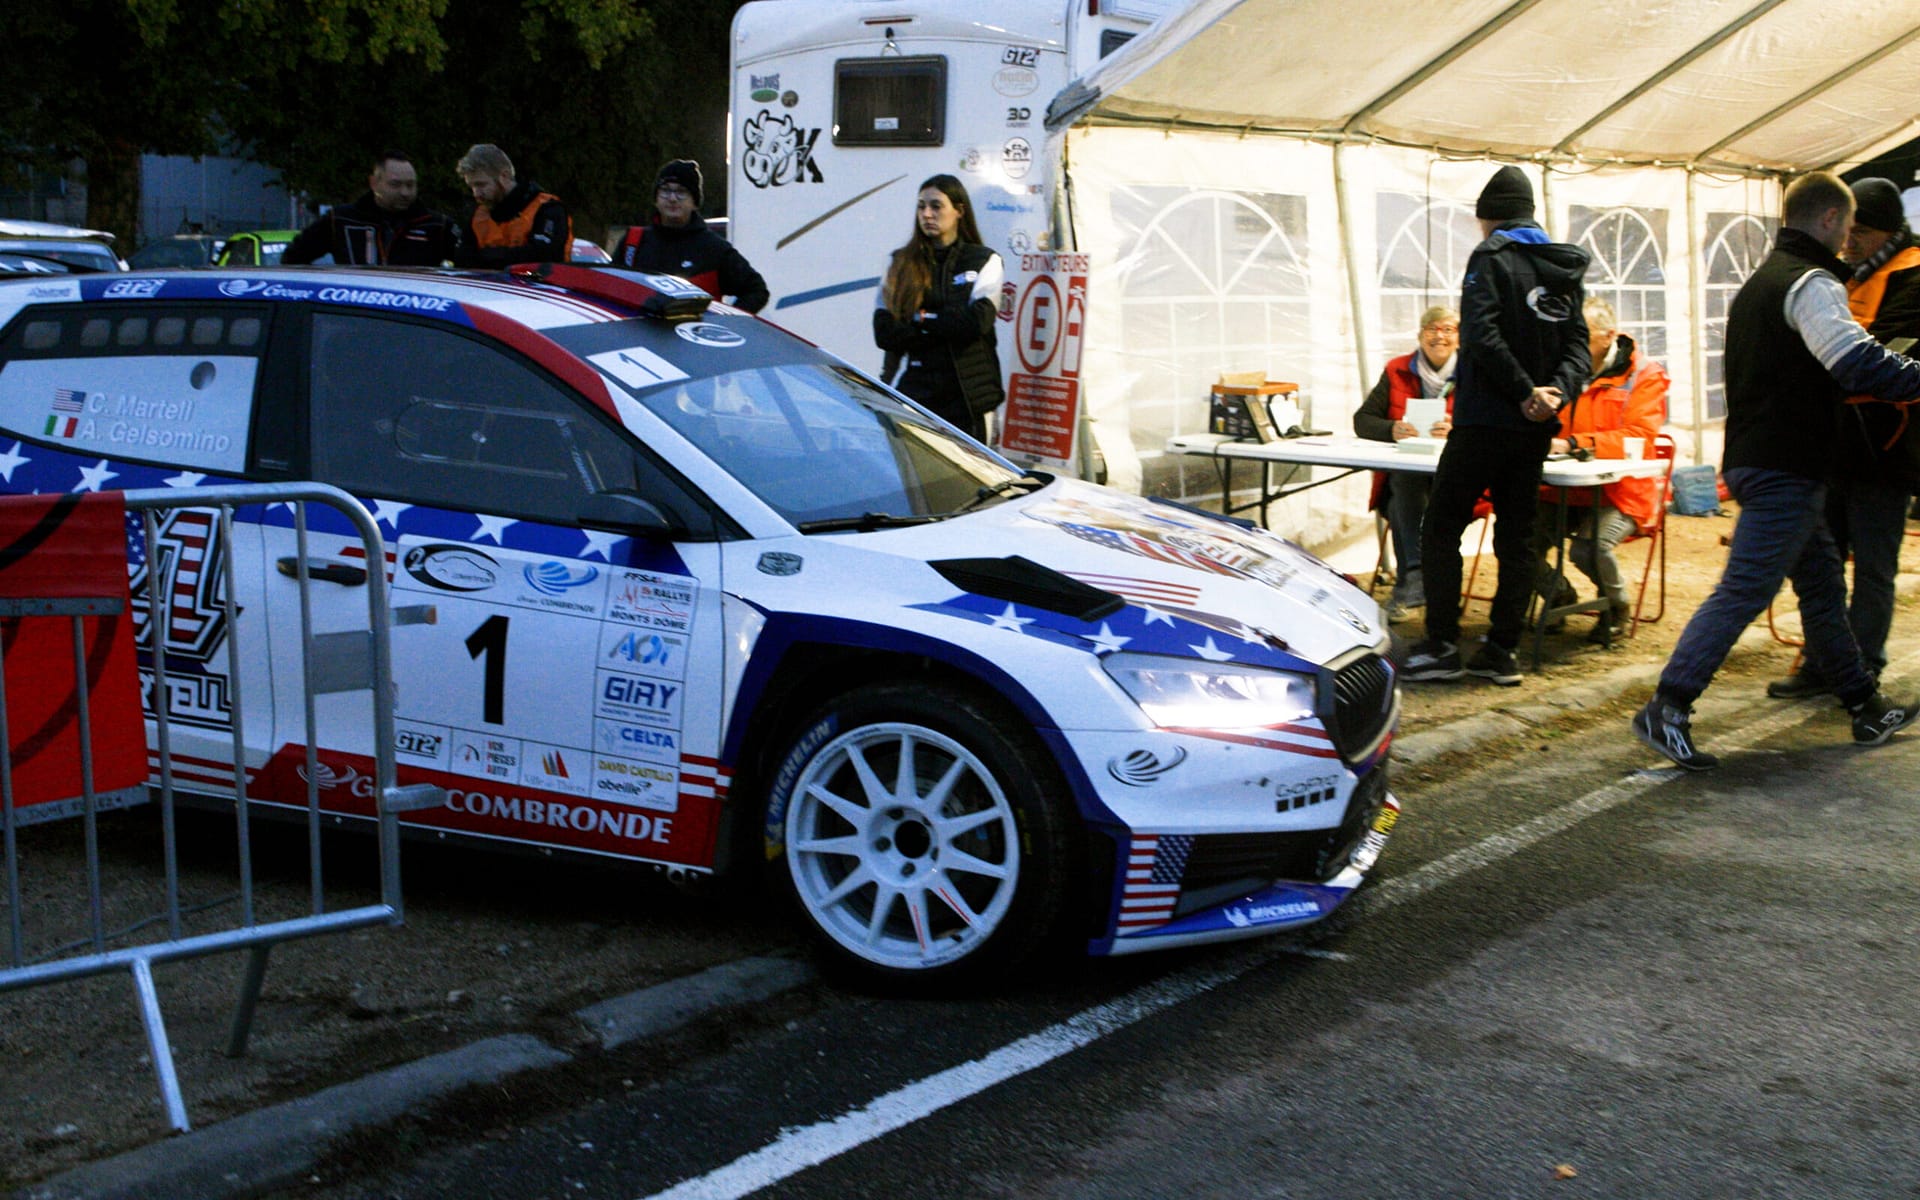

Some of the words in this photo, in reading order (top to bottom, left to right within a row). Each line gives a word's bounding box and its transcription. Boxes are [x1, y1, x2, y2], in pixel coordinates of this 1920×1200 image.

[1022, 254, 1089, 273] EXTINCTEURS
[262, 284, 315, 301] Groupe
[318, 287, 454, 312] COMBRONDE
[1030, 296, 1050, 351] E
[618, 352, 663, 380] 1
[88, 391, 109, 414] C.
[115, 394, 195, 421] Martell
[81, 419, 101, 440] A.
[110, 421, 231, 452] Gelsomino
[653, 588, 692, 603] RALLYE
[610, 610, 651, 625] MONTS
[464, 614, 511, 726] 1
[604, 676, 678, 709] GIRY
[621, 727, 676, 750] CELTA
[598, 759, 629, 775] DAVID
[768, 720, 831, 818] MICHELIN
[445, 788, 673, 844] COMBRONDE
[1250, 901, 1321, 919] MICHELIN
